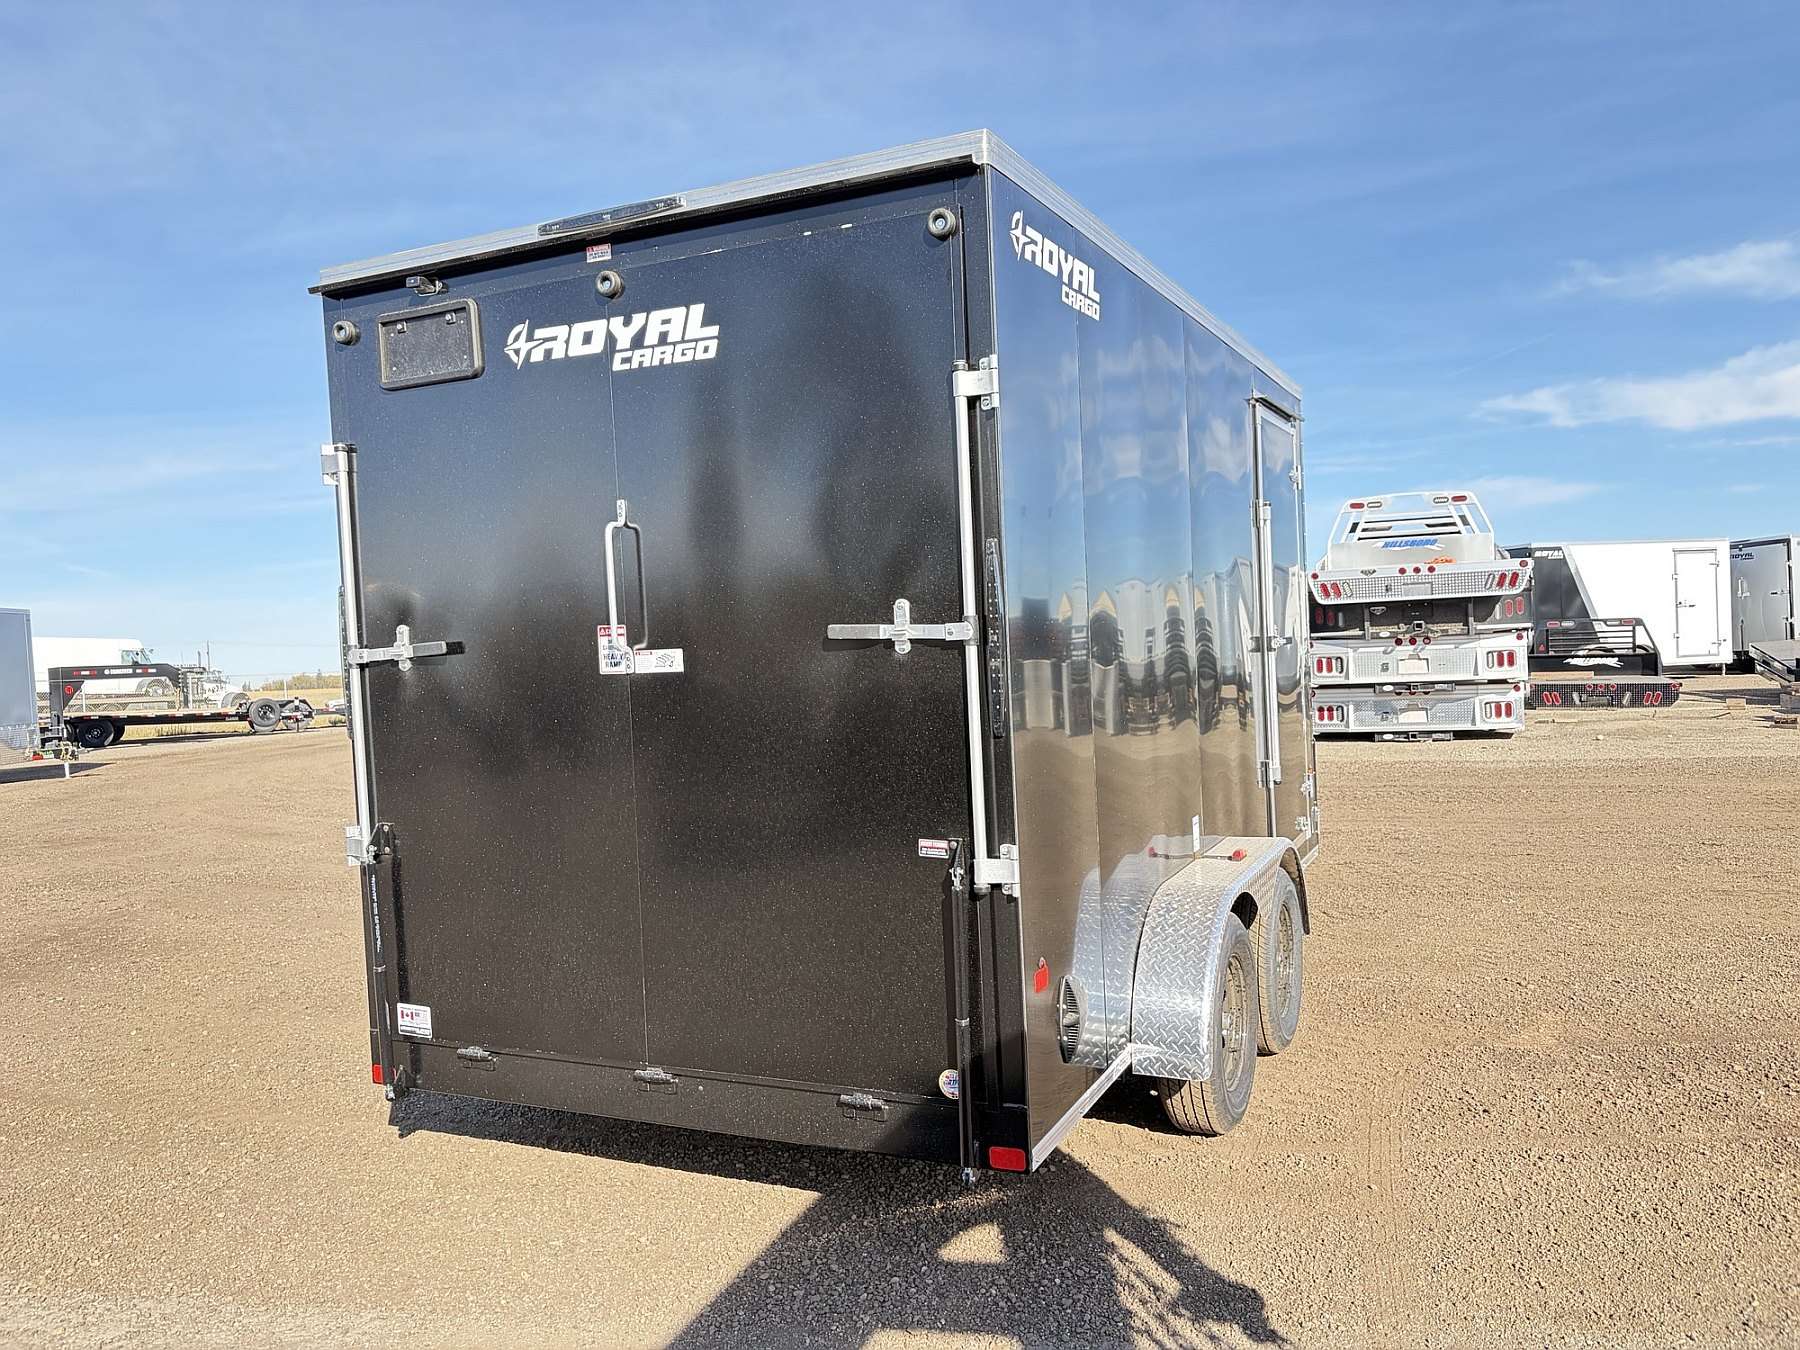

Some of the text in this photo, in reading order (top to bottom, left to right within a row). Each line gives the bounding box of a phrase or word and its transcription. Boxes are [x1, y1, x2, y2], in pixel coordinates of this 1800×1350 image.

[1025, 225, 1100, 303] ROYAL
[1062, 284, 1100, 321] CARGO
[529, 303, 720, 363] ROYAL
[612, 338, 719, 372] CARGO
